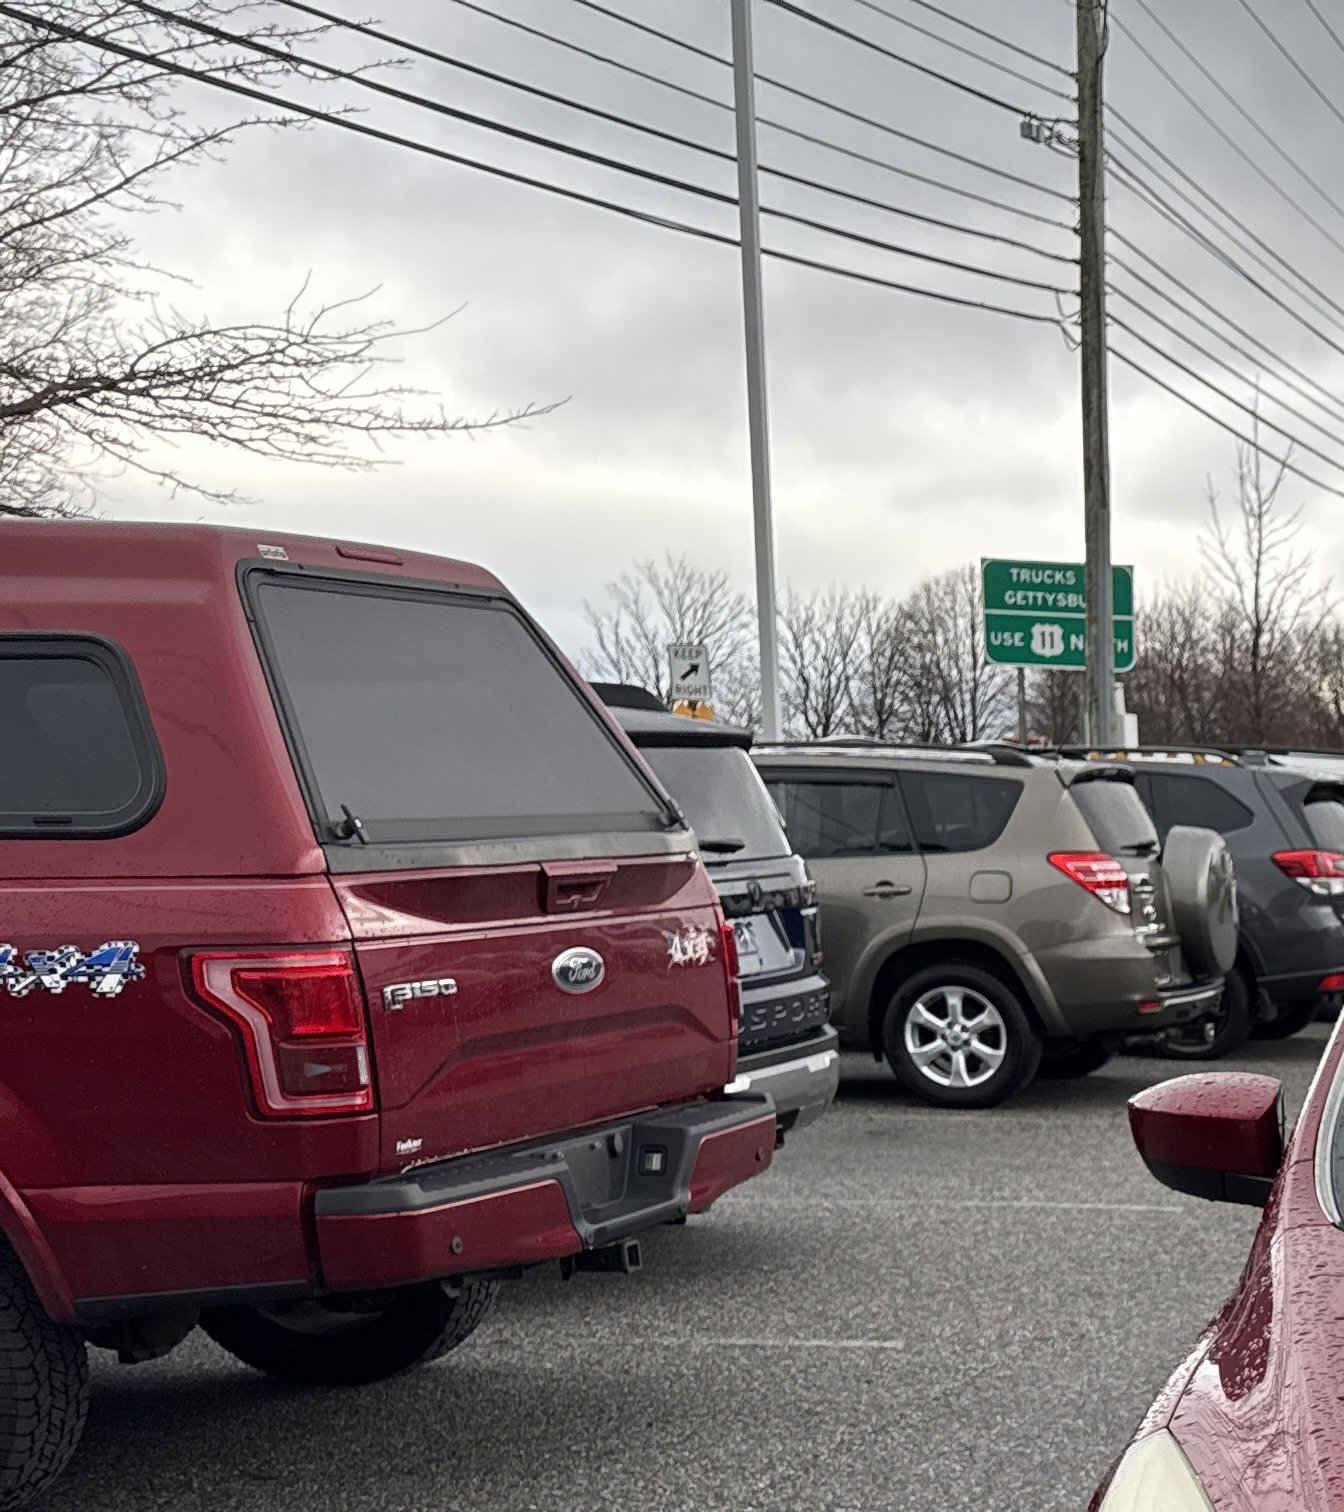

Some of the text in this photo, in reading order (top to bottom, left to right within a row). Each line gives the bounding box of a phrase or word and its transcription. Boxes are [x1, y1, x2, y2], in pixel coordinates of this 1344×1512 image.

[1010, 567, 1076, 585] TRUCKS
[1004, 590, 1087, 608] GETTYSBU
[990, 631, 1025, 647] USE
[1039, 630, 1055, 650] 11
[674, 647, 703, 660] KEEP
[675, 683, 707, 697] RIGHT
[568, 956, 597, 982] Ford
